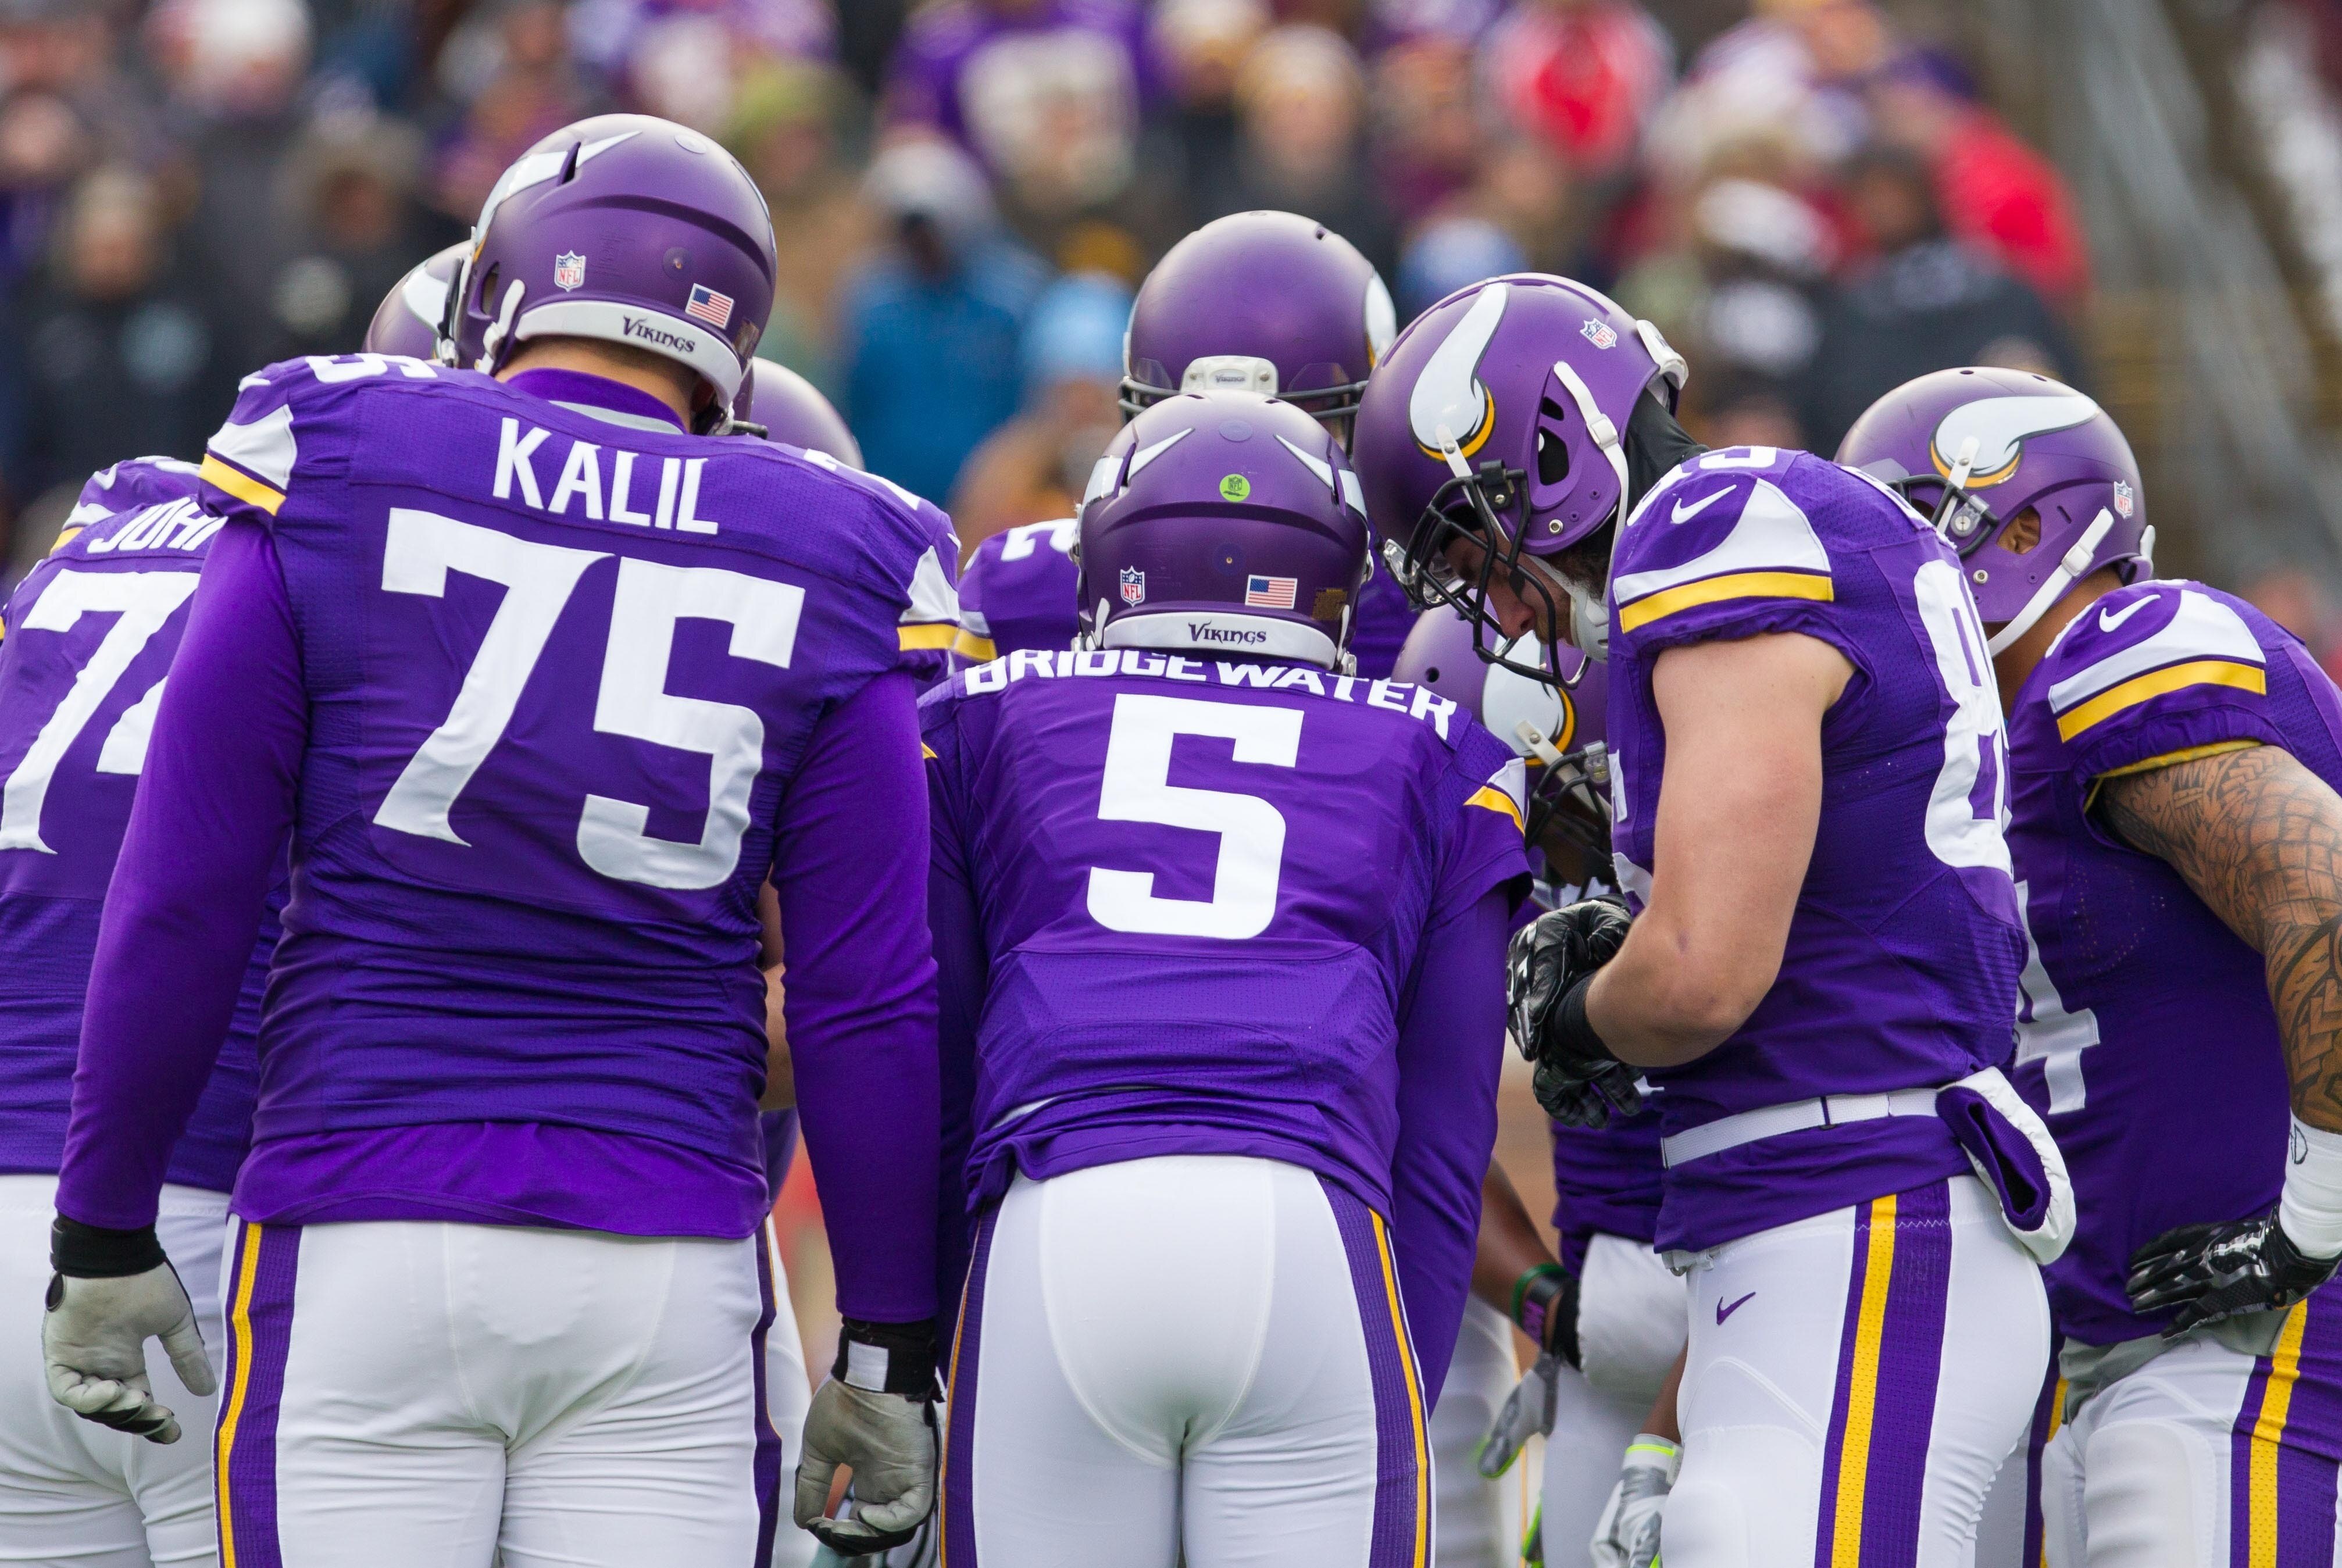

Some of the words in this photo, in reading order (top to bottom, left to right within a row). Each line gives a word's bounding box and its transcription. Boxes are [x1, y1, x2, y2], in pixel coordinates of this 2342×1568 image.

[558, 269, 580, 284] NFL
[87, 497, 229, 554] JOH
[492, 417, 718, 535] KALIL
[1124, 584, 1141, 600] NFL
[373, 507, 806, 890] 75
[1913, 559, 2015, 881] 8
[1087, 693, 1304, 940] 5
